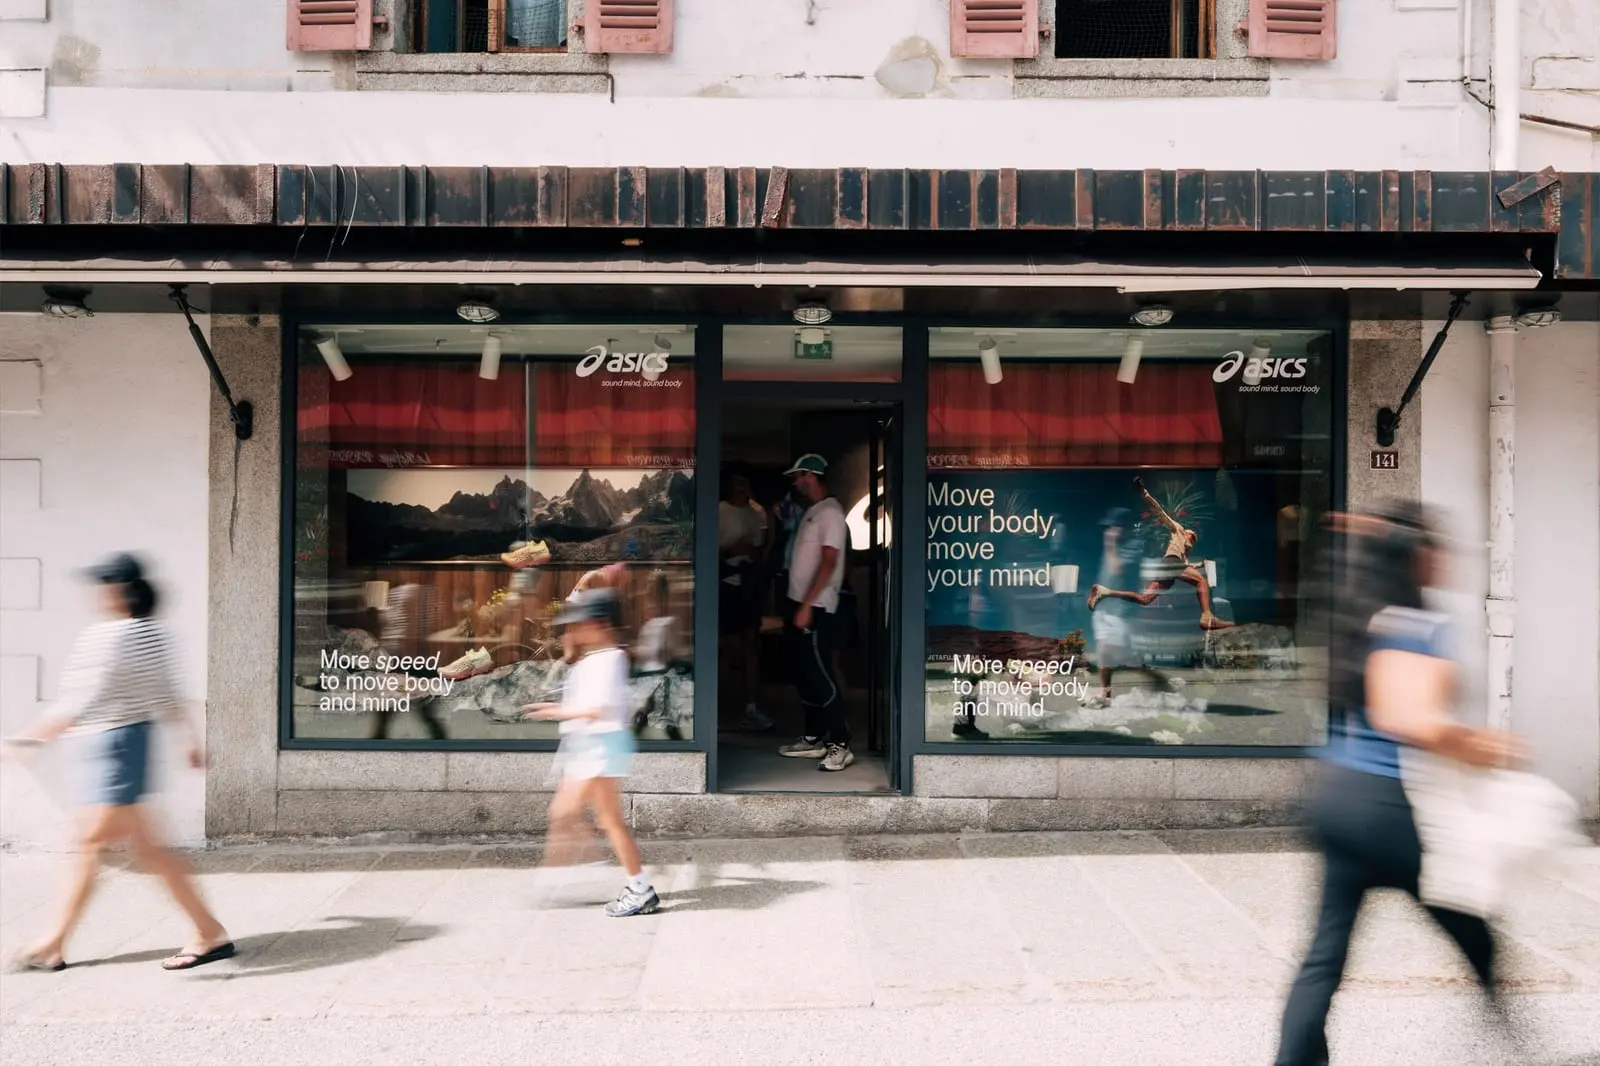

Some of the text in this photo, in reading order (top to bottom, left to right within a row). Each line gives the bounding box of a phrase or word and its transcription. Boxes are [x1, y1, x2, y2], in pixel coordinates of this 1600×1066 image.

[601, 379, 683, 389] sound mind, sound body
[1239, 384, 1321, 395] sound mind, sound body
[1376, 454, 1395, 467] 141
[927, 481, 995, 506] Move
[927, 508, 1057, 540] your body,
[927, 541, 995, 560] move
[927, 562, 1050, 593] your mind
[321, 649, 441, 675] More speed
[952, 653, 1075, 679] More speed
[319, 671, 456, 697] to move body
[952, 676, 1089, 701] to move body
[319, 692, 411, 712] and mind
[952, 697, 1045, 717] and mind
